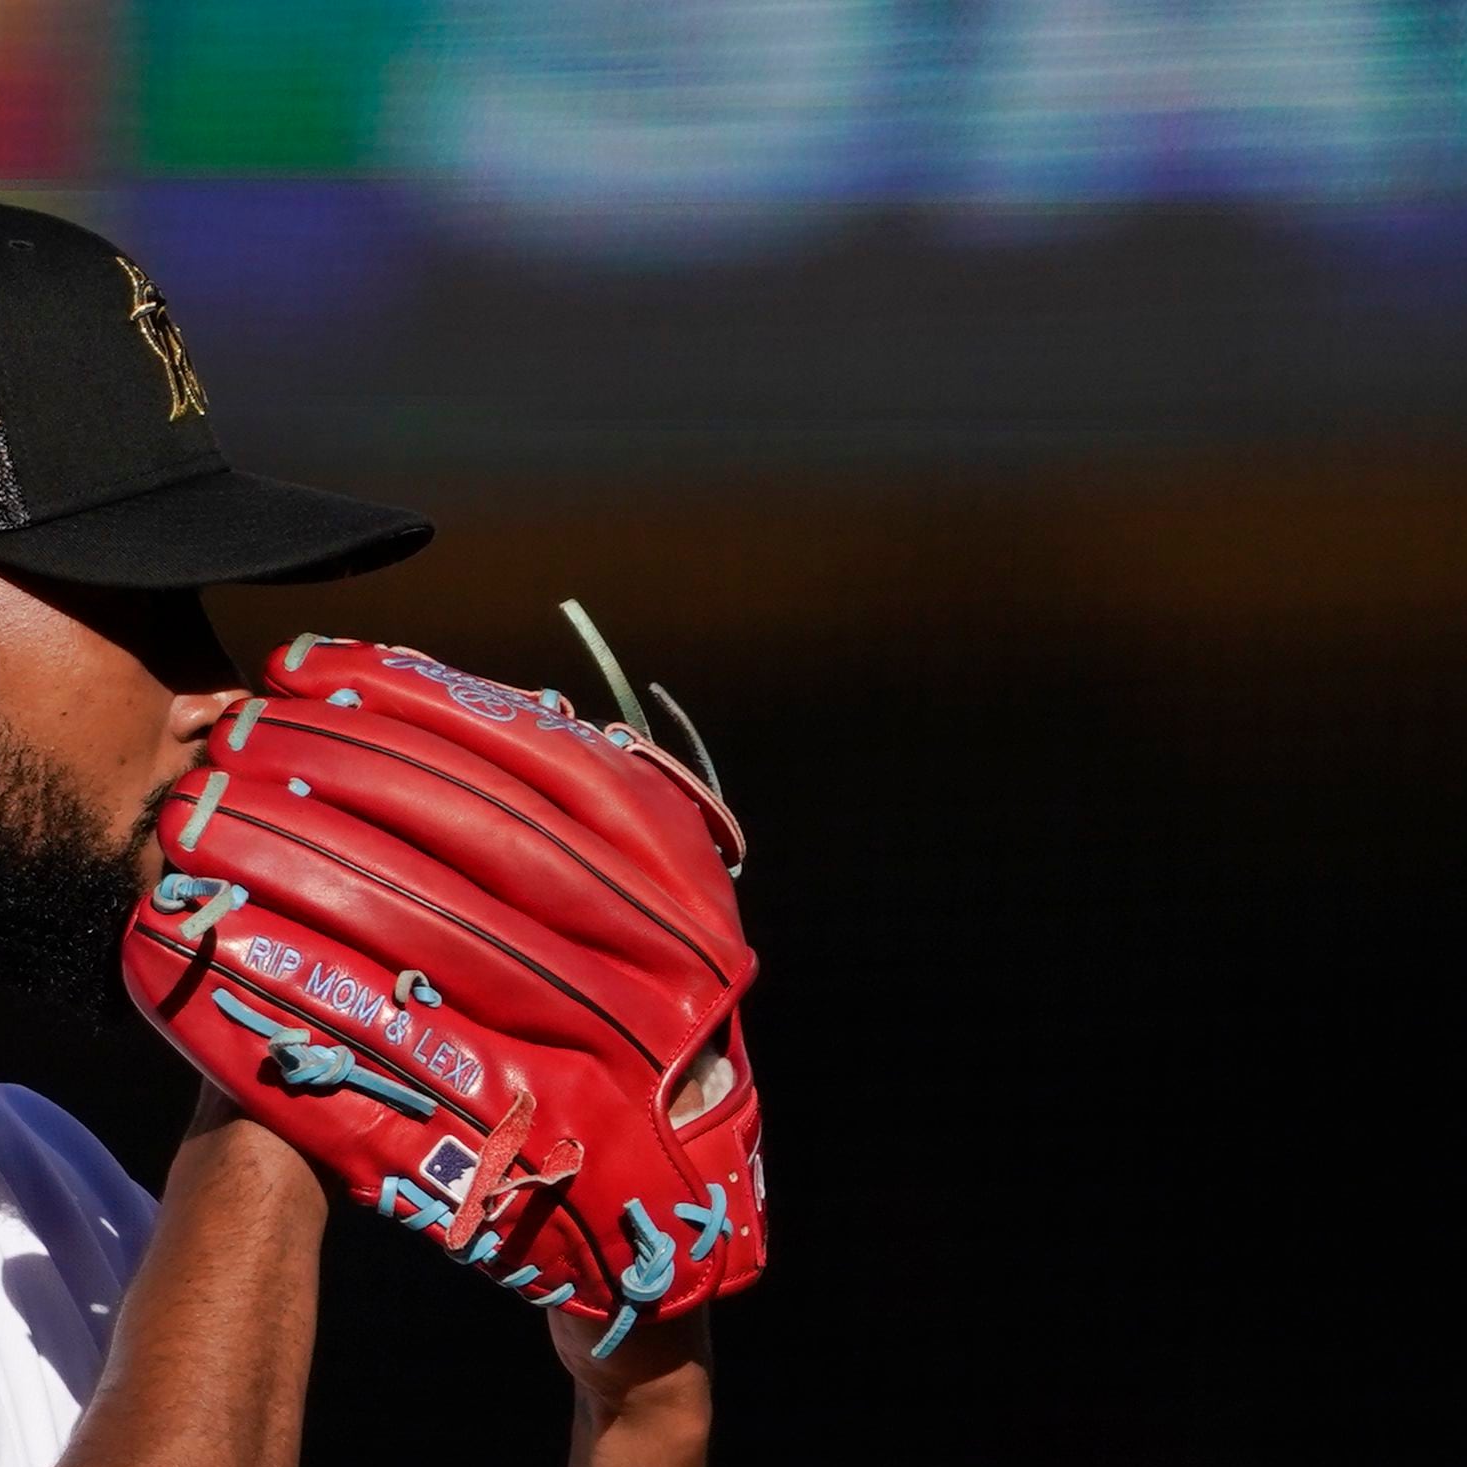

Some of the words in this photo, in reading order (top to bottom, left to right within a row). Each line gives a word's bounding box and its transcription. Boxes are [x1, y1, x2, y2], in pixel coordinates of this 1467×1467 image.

[244, 934, 303, 979] RIP
[304, 961, 386, 1029] MOM
[384, 1010, 412, 1046] &
[411, 1027, 483, 1096] LEXI
